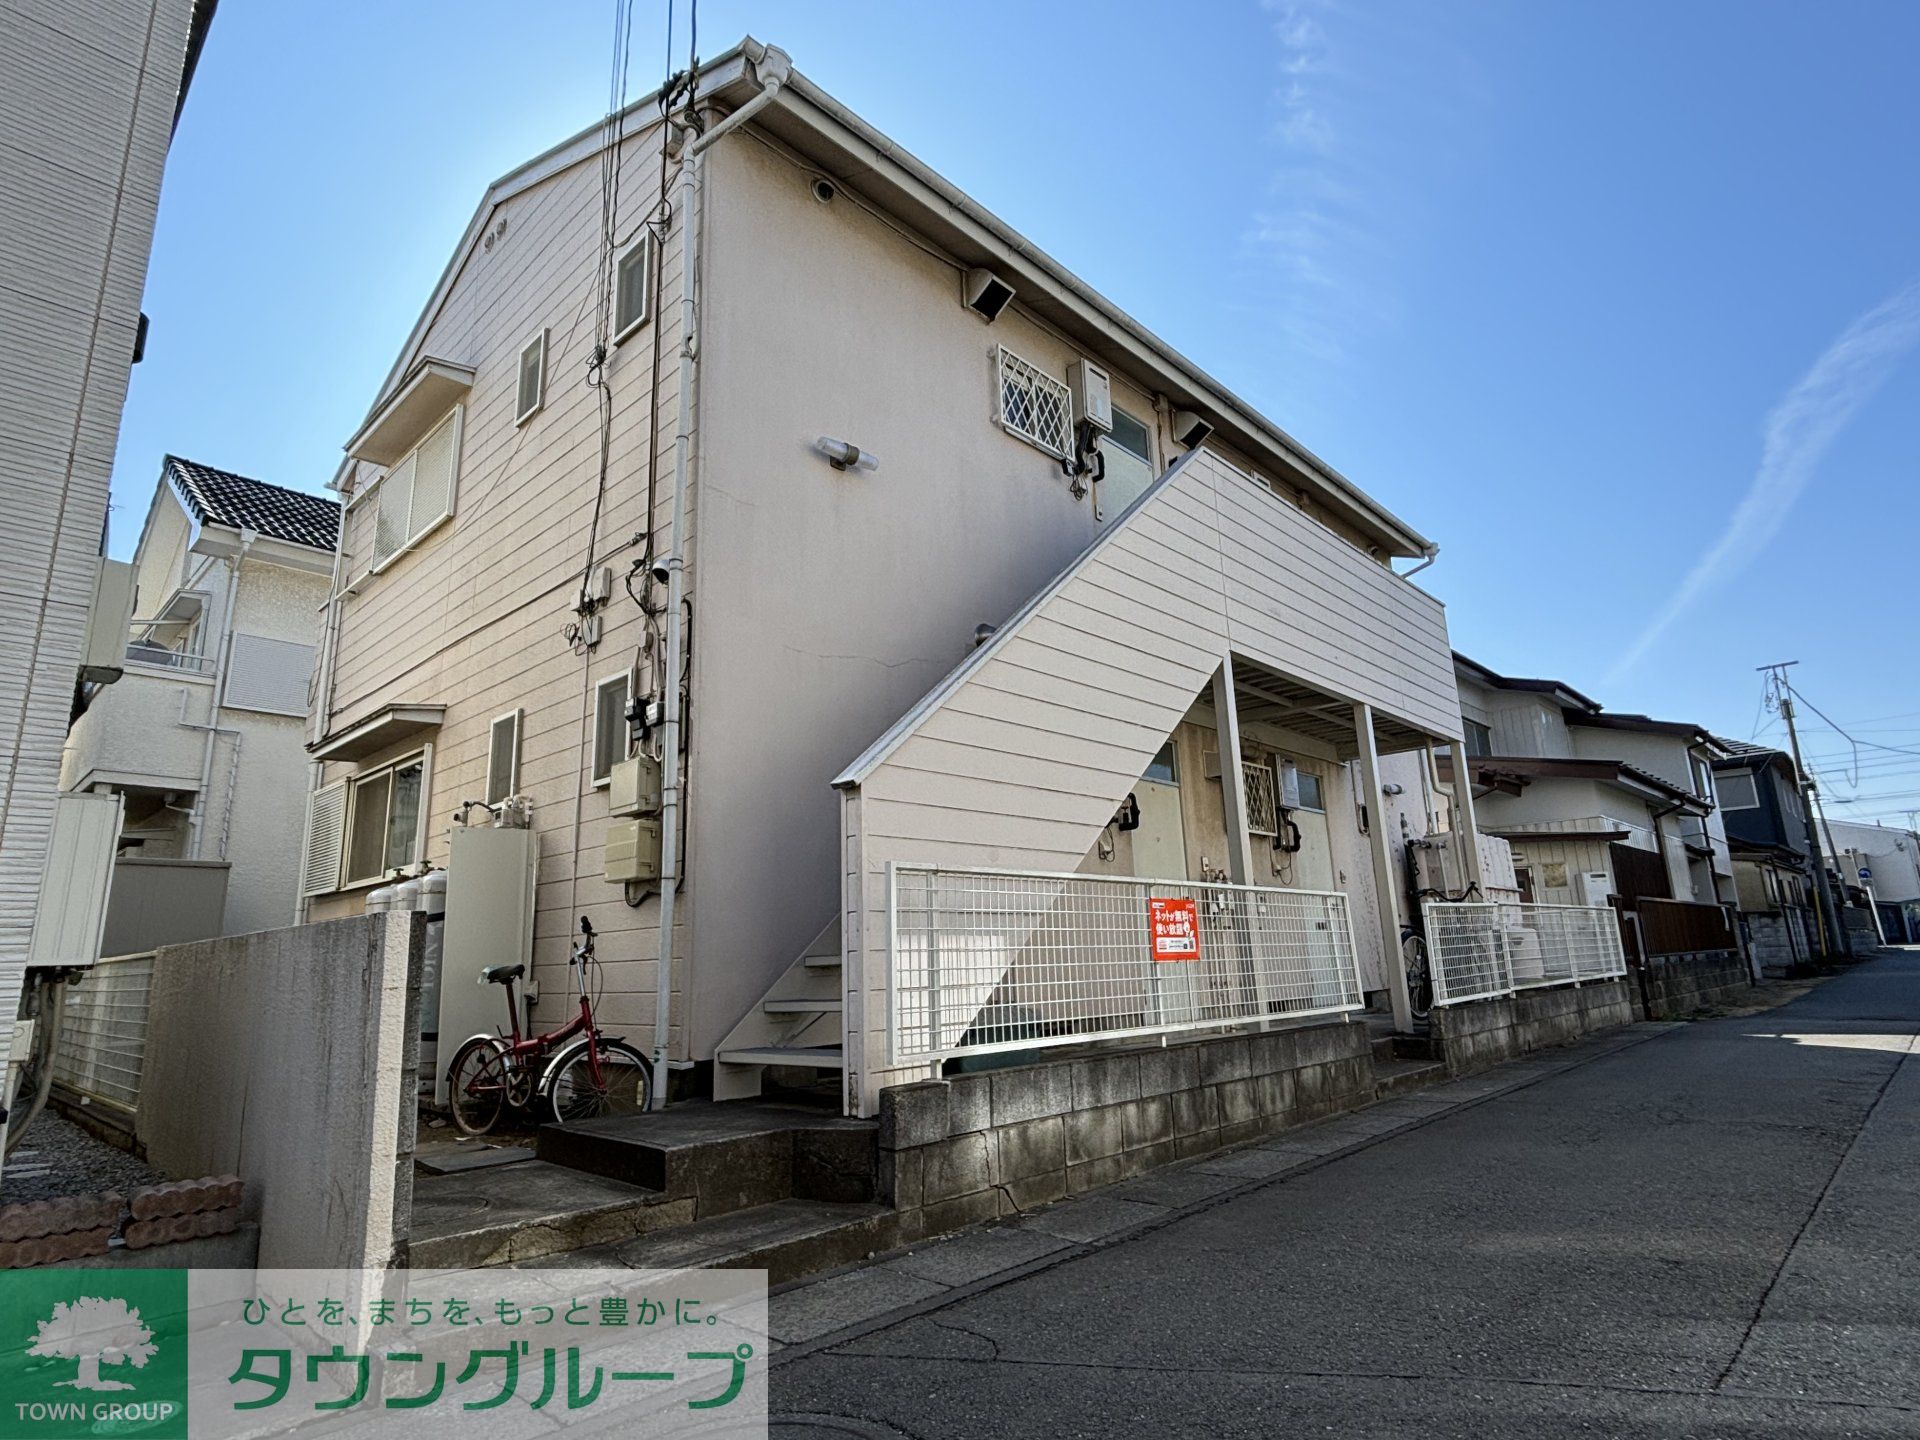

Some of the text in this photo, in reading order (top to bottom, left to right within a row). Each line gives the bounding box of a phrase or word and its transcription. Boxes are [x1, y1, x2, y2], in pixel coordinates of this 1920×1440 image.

[1155, 909, 1194, 922] ネットが無料で
